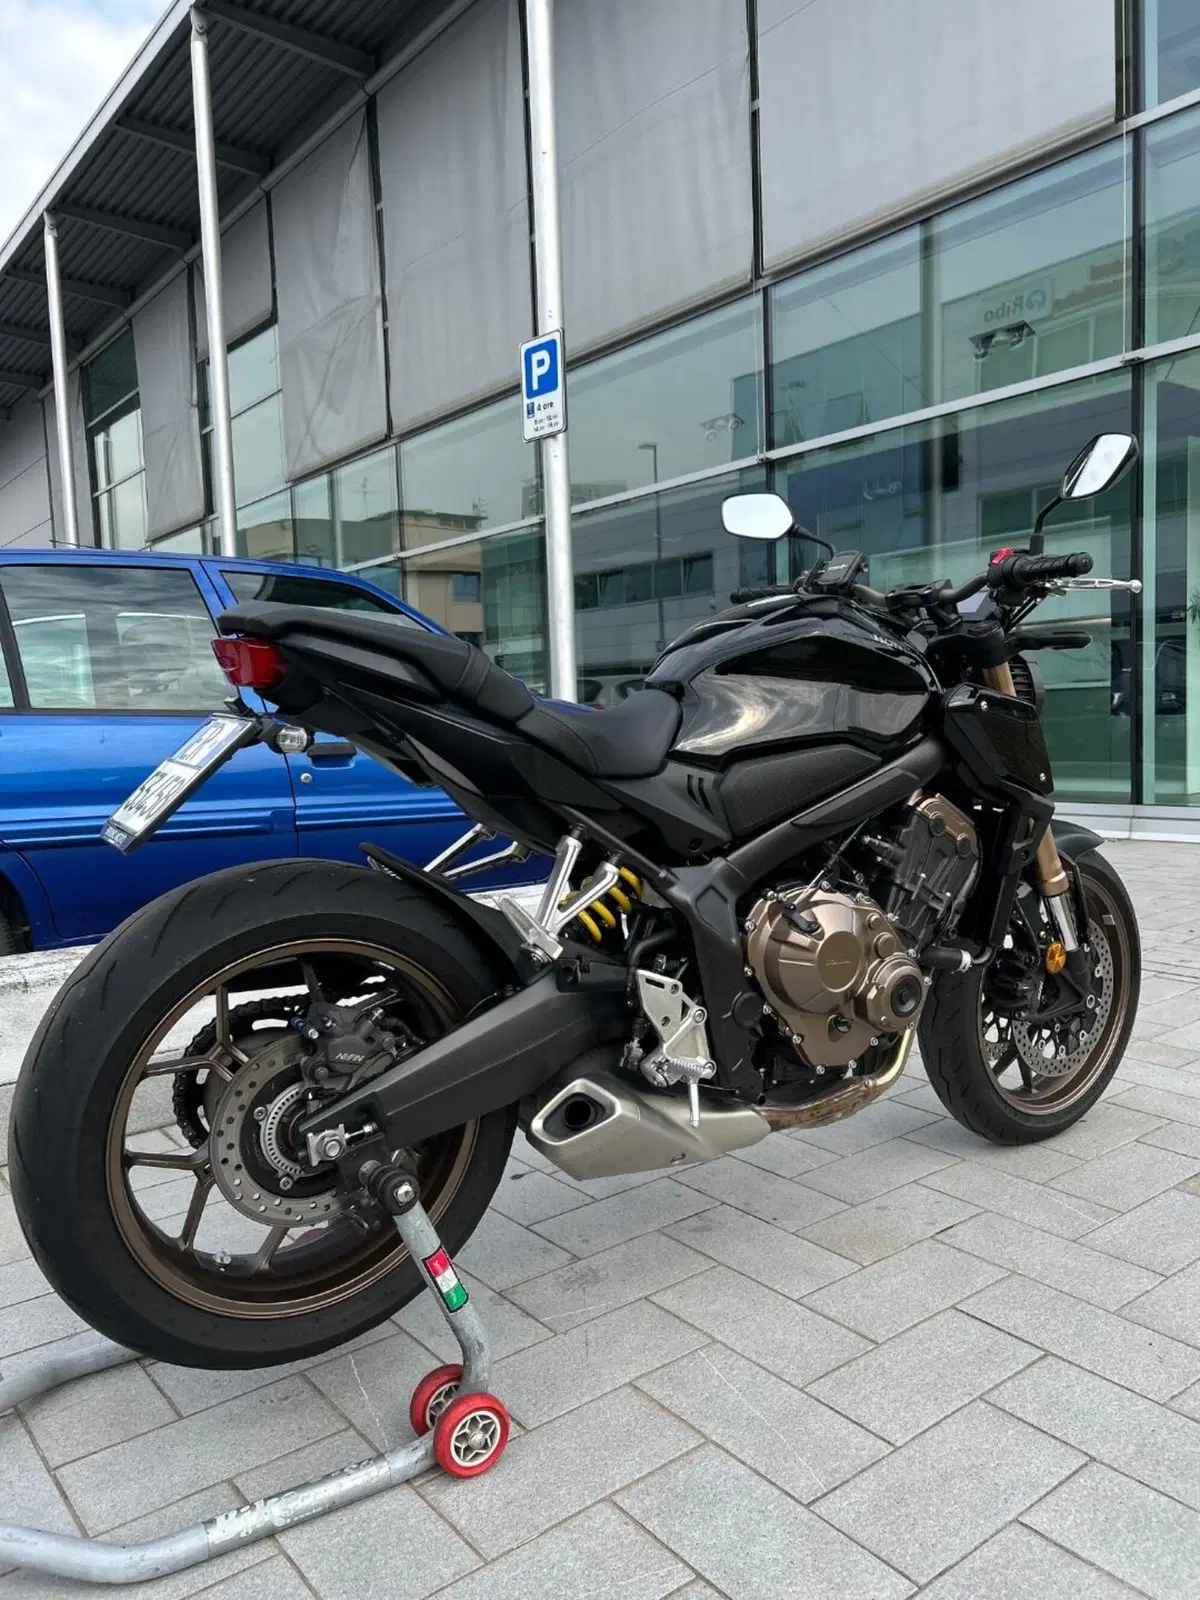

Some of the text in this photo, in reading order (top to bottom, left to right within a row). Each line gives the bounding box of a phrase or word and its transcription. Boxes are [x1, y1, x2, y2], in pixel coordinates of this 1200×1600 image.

[531, 349, 551, 391] P
[536, 401, 554, 411] 4 ore
